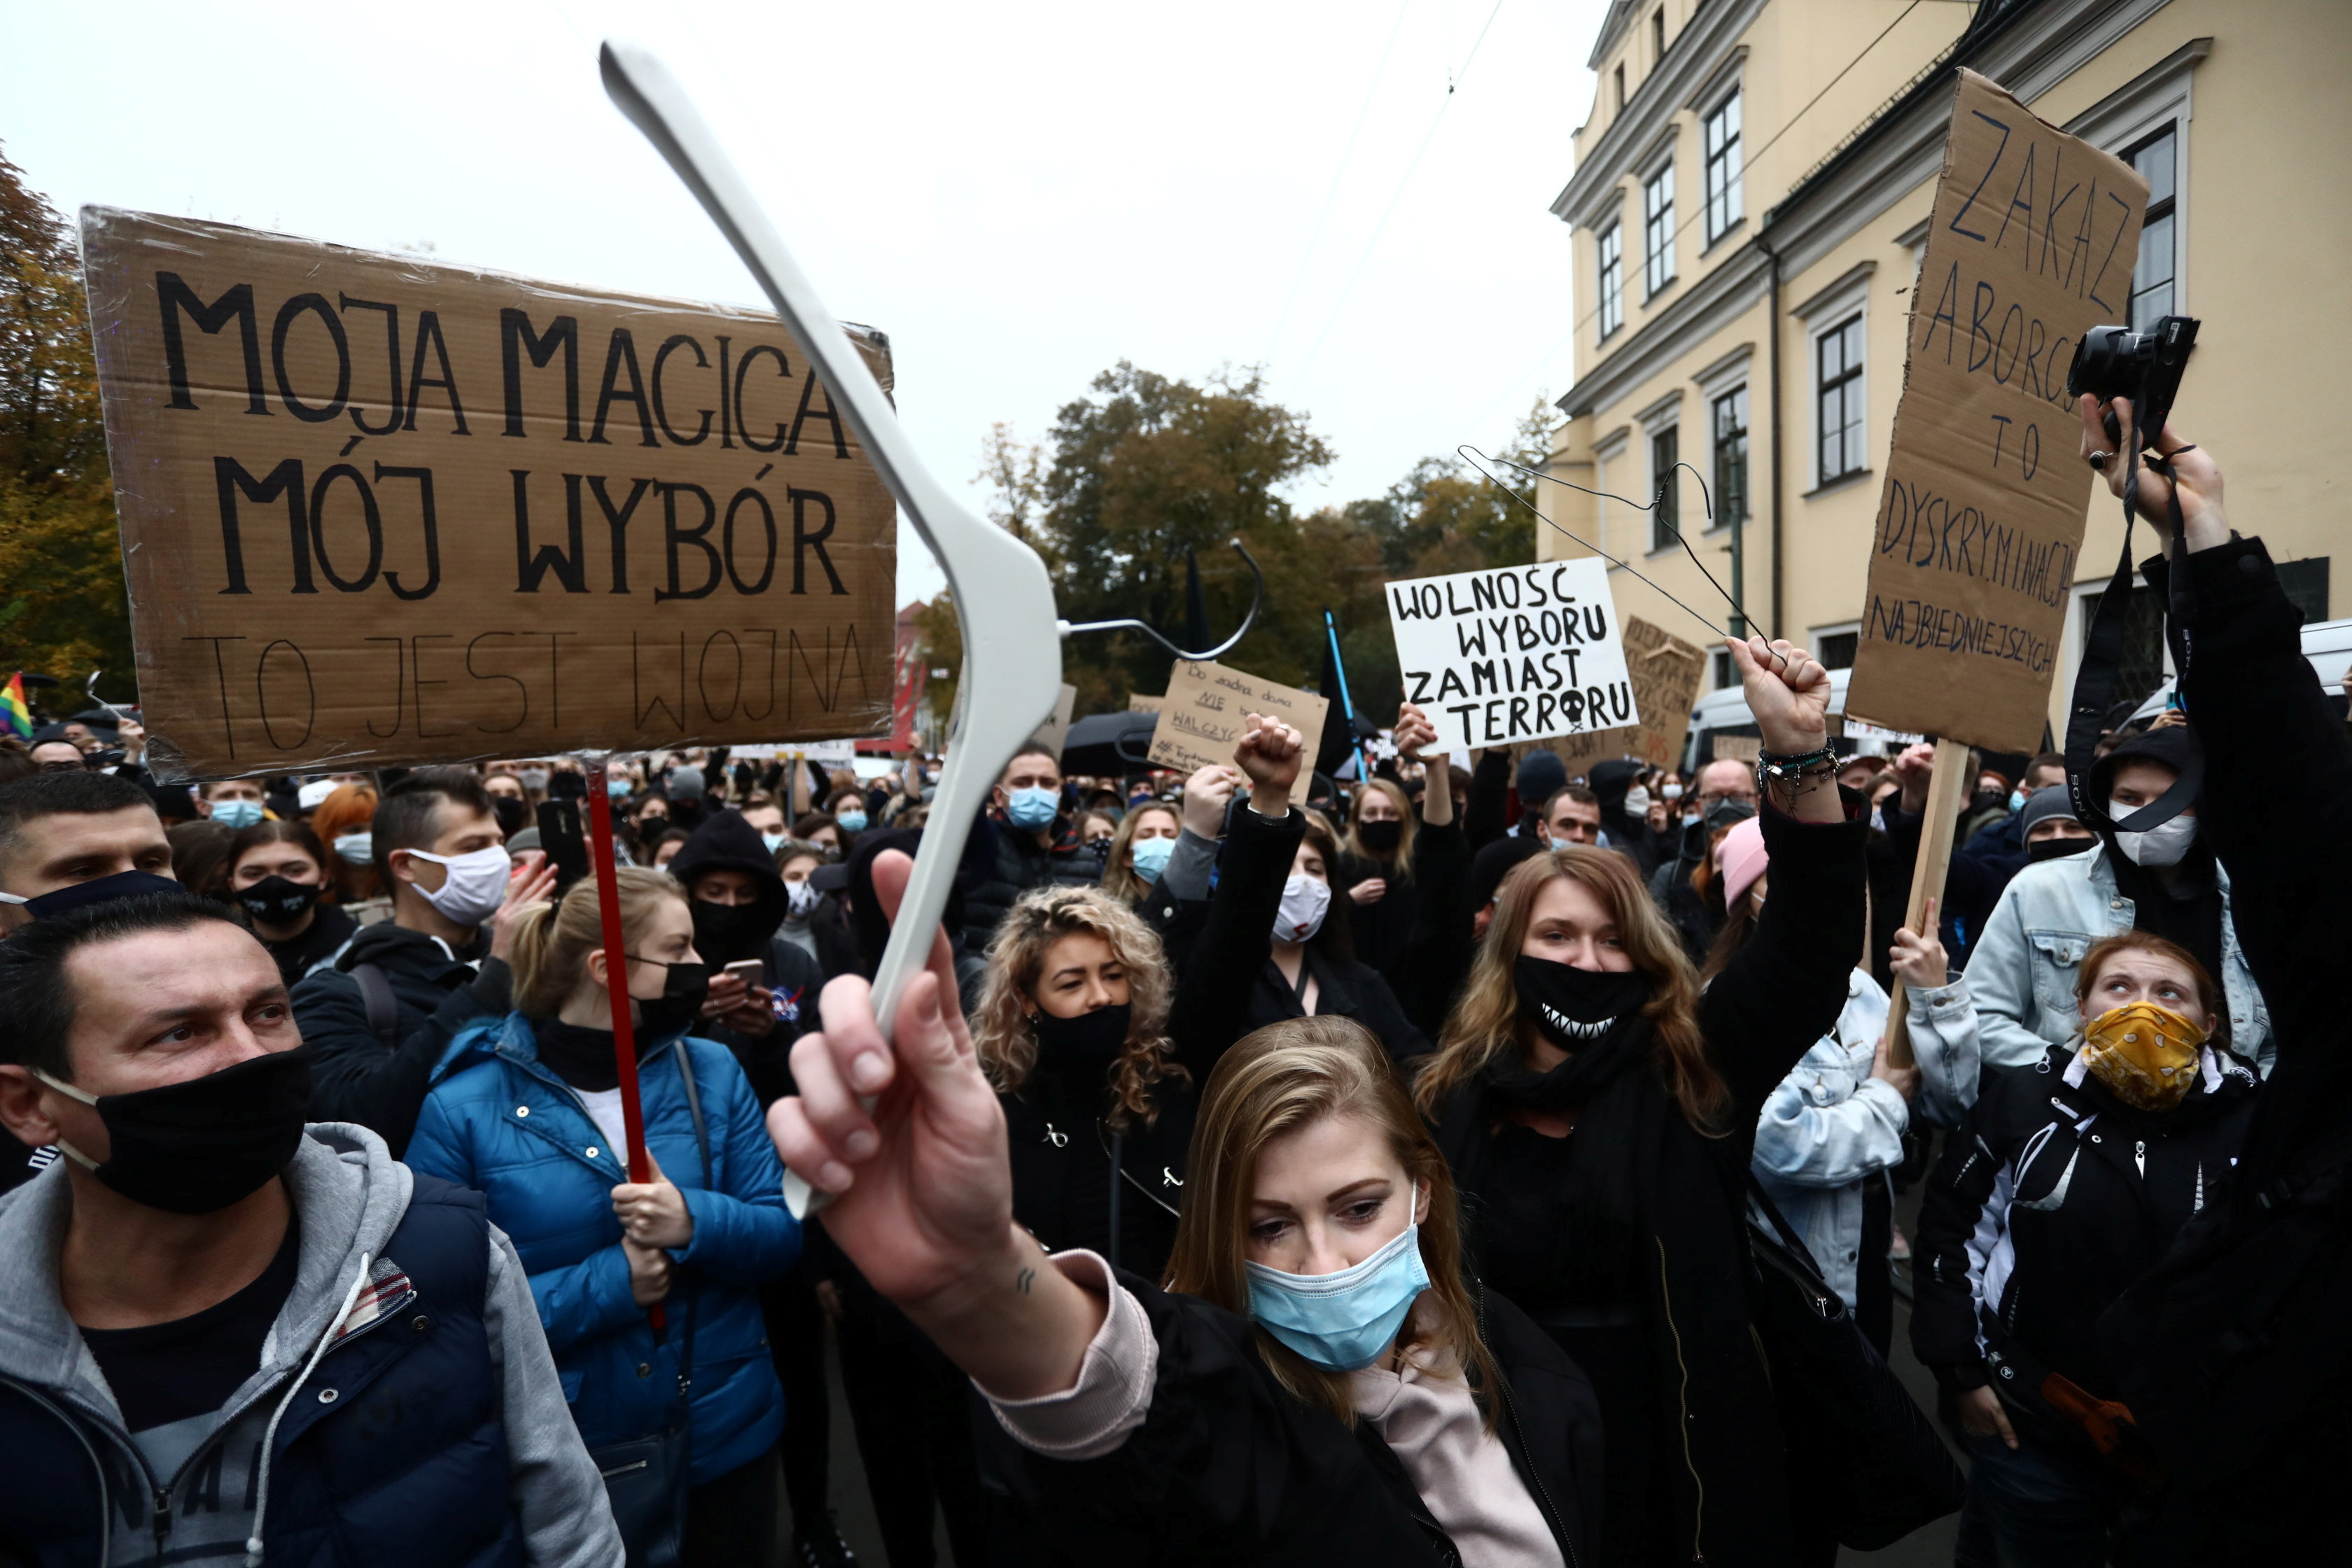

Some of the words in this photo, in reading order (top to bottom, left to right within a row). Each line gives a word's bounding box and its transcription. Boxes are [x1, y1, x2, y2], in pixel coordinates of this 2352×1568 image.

[1949, 109, 2131, 316] ZAKAZ
[155, 270, 472, 435] MOJA
[1991, 414, 2040, 481] TO
[213, 435, 441, 601] MÓJ
[508, 463, 850, 605] WYBÓR
[1881, 479, 2073, 612] DYSKRYMINACJA
[1405, 648, 1581, 705] ZAMIAST
[1457, 604, 1606, 657] WYBORU
[1869, 594, 2055, 677] NAJBIEDNIEJSZYCH
[181, 636, 315, 760] TO
[364, 631, 578, 738] JEST
[633, 622, 872, 733] WOJNA
[1198, 691, 1226, 709] NIE
